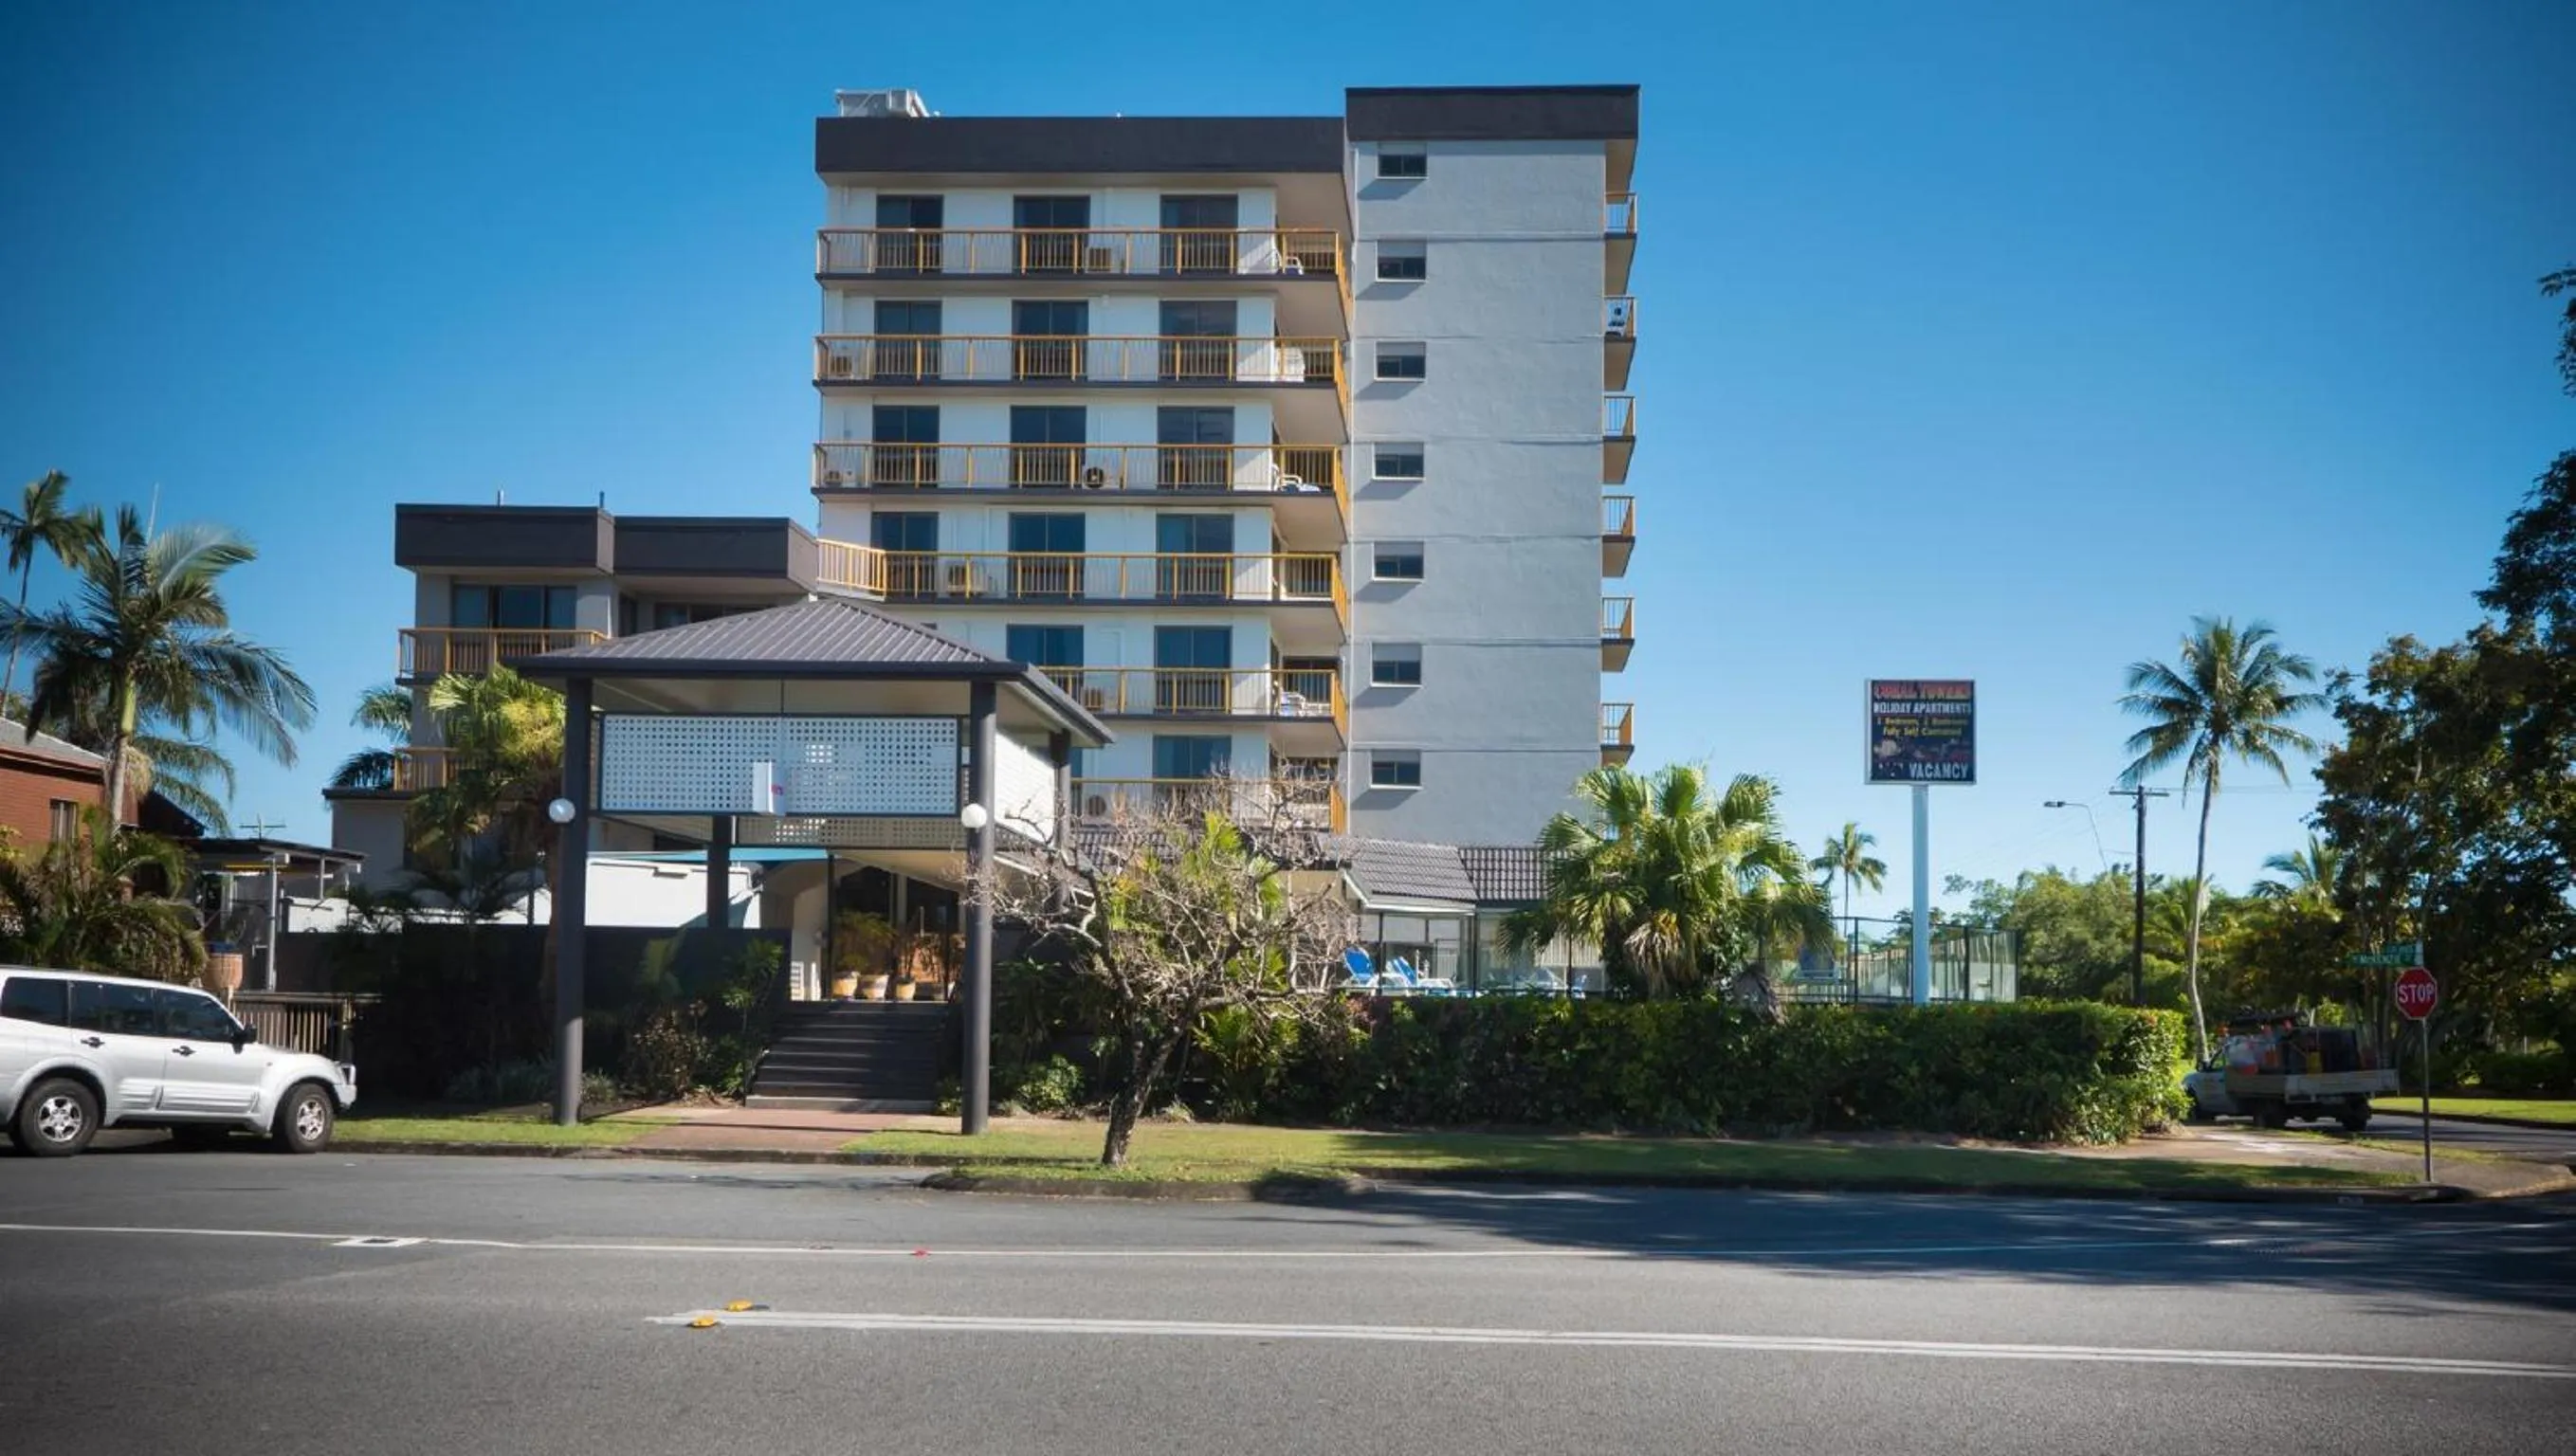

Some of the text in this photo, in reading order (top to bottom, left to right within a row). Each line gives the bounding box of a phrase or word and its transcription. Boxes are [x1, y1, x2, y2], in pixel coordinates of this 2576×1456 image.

[1873, 701, 1972, 714] HOLIDAY APARTMENTS
[1909, 762, 1968, 779] VACANCY
[2399, 984, 2435, 1003] STOP
